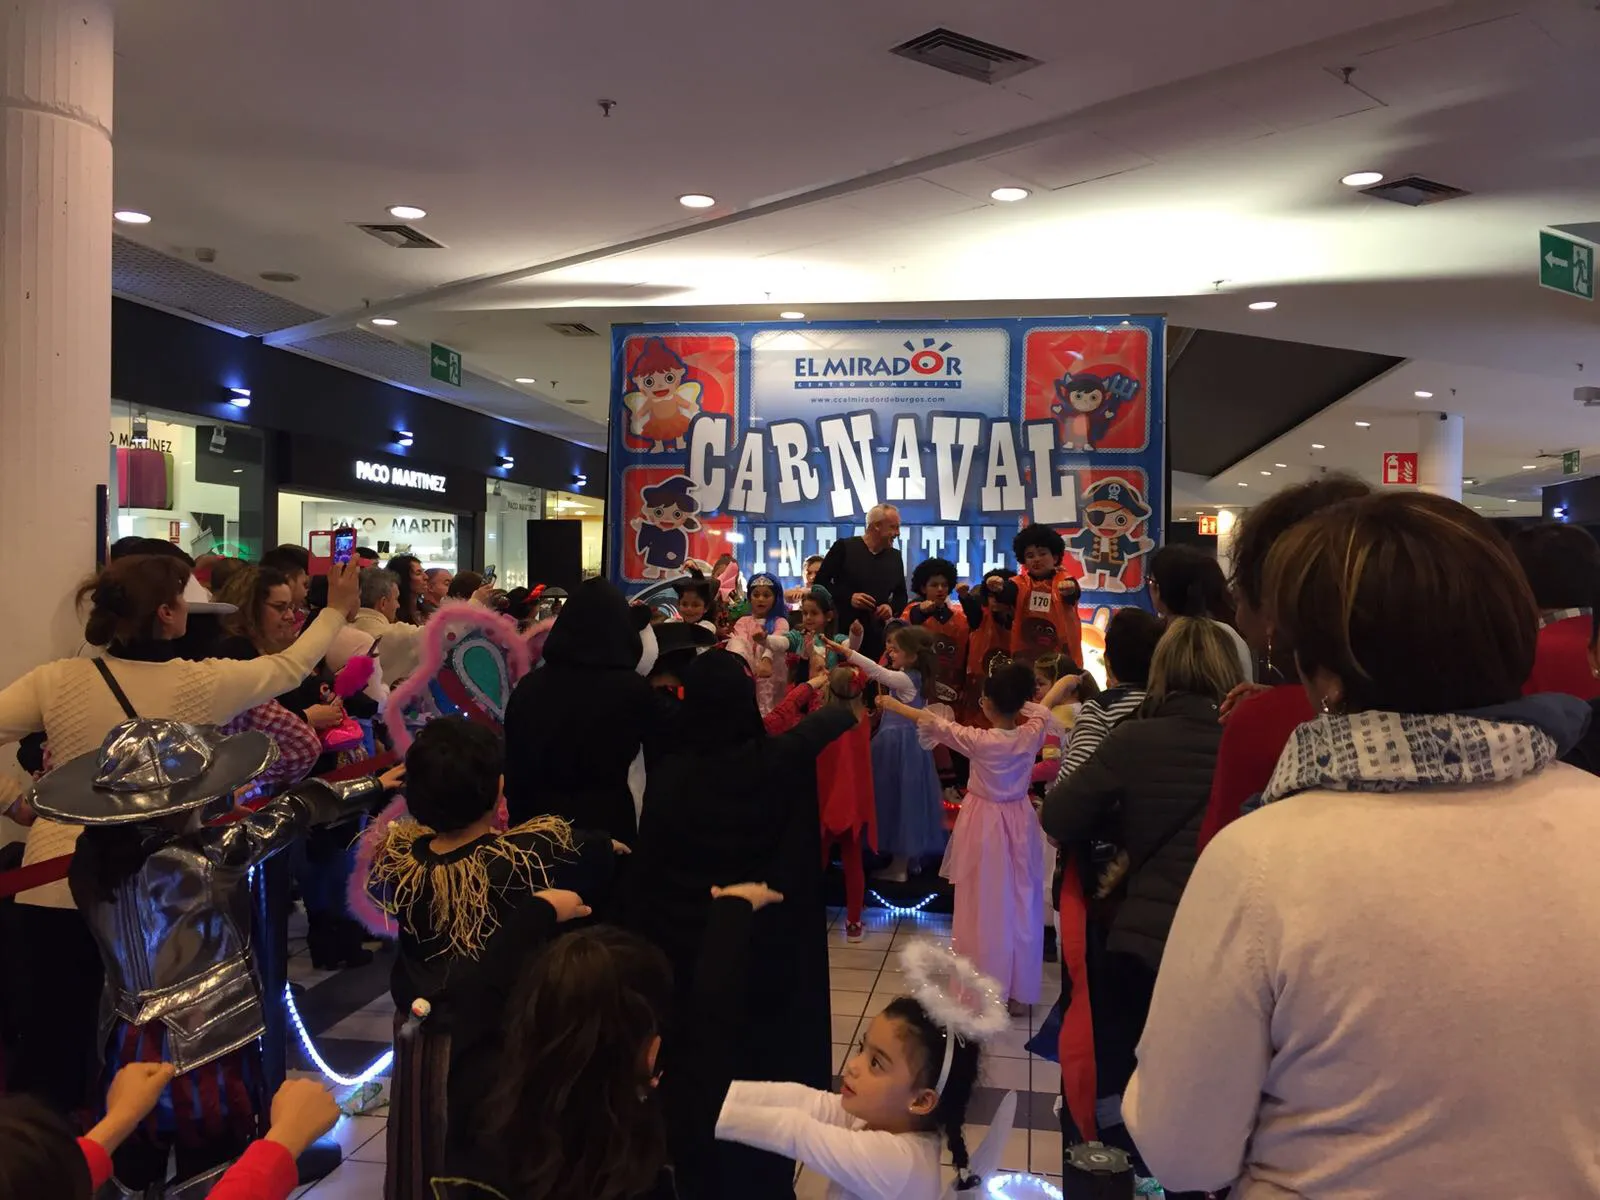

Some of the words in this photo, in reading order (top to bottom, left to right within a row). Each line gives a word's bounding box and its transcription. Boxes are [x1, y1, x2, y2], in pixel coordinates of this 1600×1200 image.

[795, 358, 818, 377] EL
[822, 351, 962, 377] MIRADOR
[356, 460, 390, 484] PACO
[392, 467, 446, 493] MARTINEZ
[690, 414, 1078, 523] CARNAVAL
[1033, 596, 1049, 607] 170
